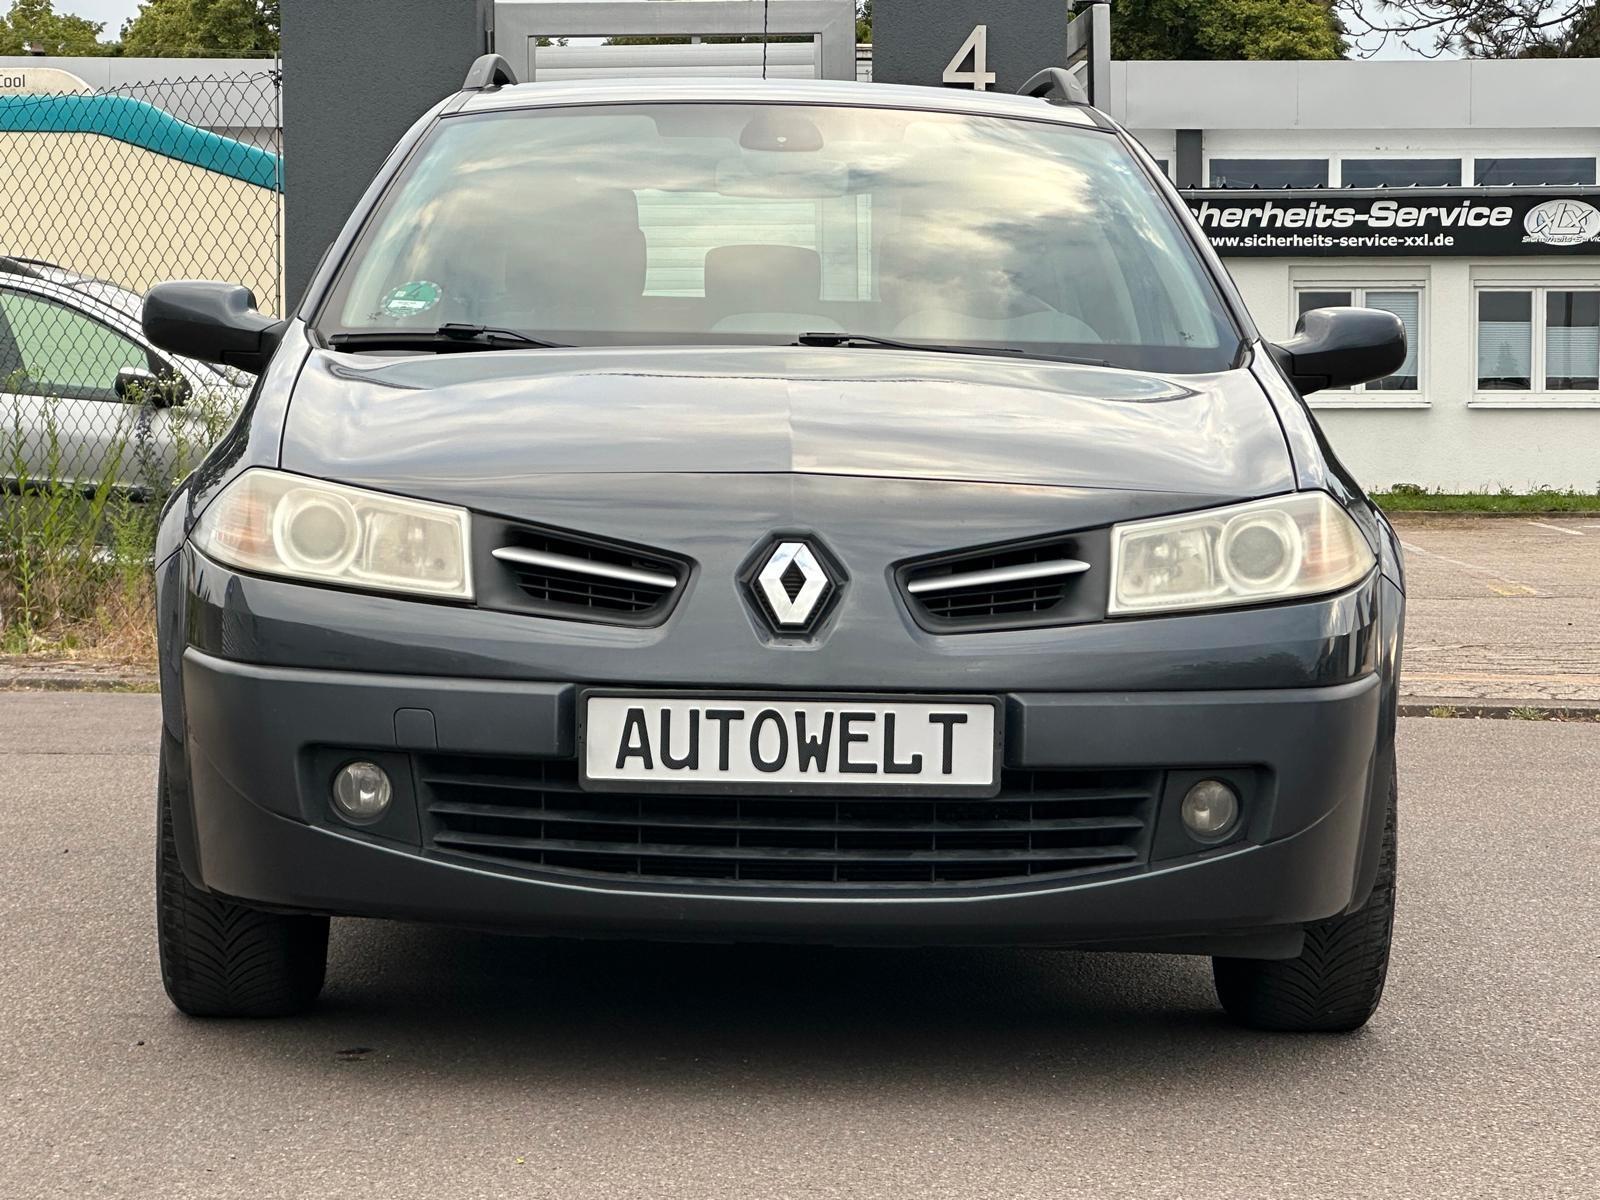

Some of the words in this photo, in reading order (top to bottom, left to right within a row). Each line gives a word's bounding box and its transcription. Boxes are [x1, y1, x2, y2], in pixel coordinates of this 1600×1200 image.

[943, 25, 996, 91] 4
[1191, 200, 1513, 228] herheits-Service
[1209, 233, 1455, 247] ww.sicherheits-service-xxl.de
[615, 707, 969, 775] AUTOWELT
